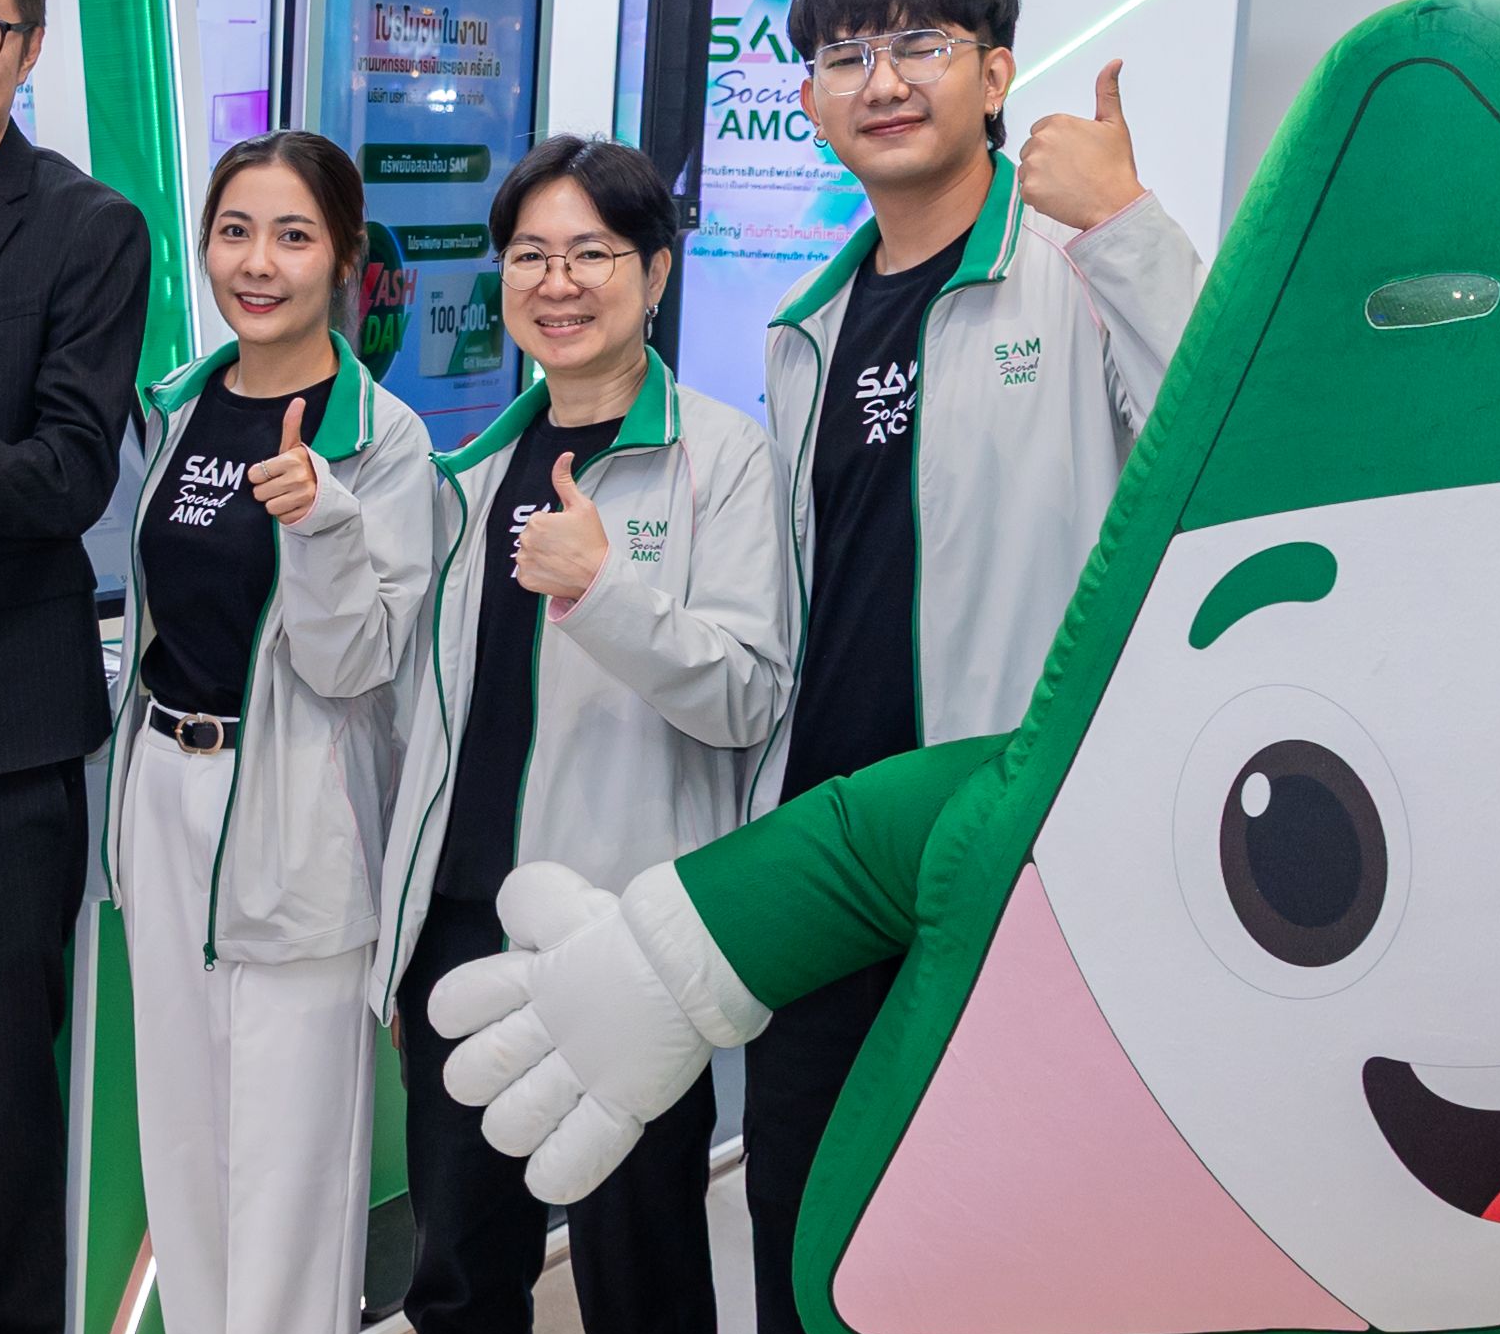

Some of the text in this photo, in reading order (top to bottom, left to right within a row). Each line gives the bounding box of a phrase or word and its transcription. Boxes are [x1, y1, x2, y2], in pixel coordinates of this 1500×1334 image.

[709, 15, 800, 64] SA
[711, 69, 801, 107] Socia
[717, 109, 811, 142] AMC
[449, 157, 469, 173] SAM
[363, 312, 412, 355] DAY
[994, 337, 1041, 361] SAM
[1000, 357, 1040, 376] Social
[1003, 371, 1037, 386] AMC
[180, 455, 246, 490] SAM
[174, 484, 234, 508] Social
[169, 504, 216, 527] AMC
[627, 519, 668, 537] SAM
[629, 537, 665, 551] Social
[631, 550, 661, 563] AMC
